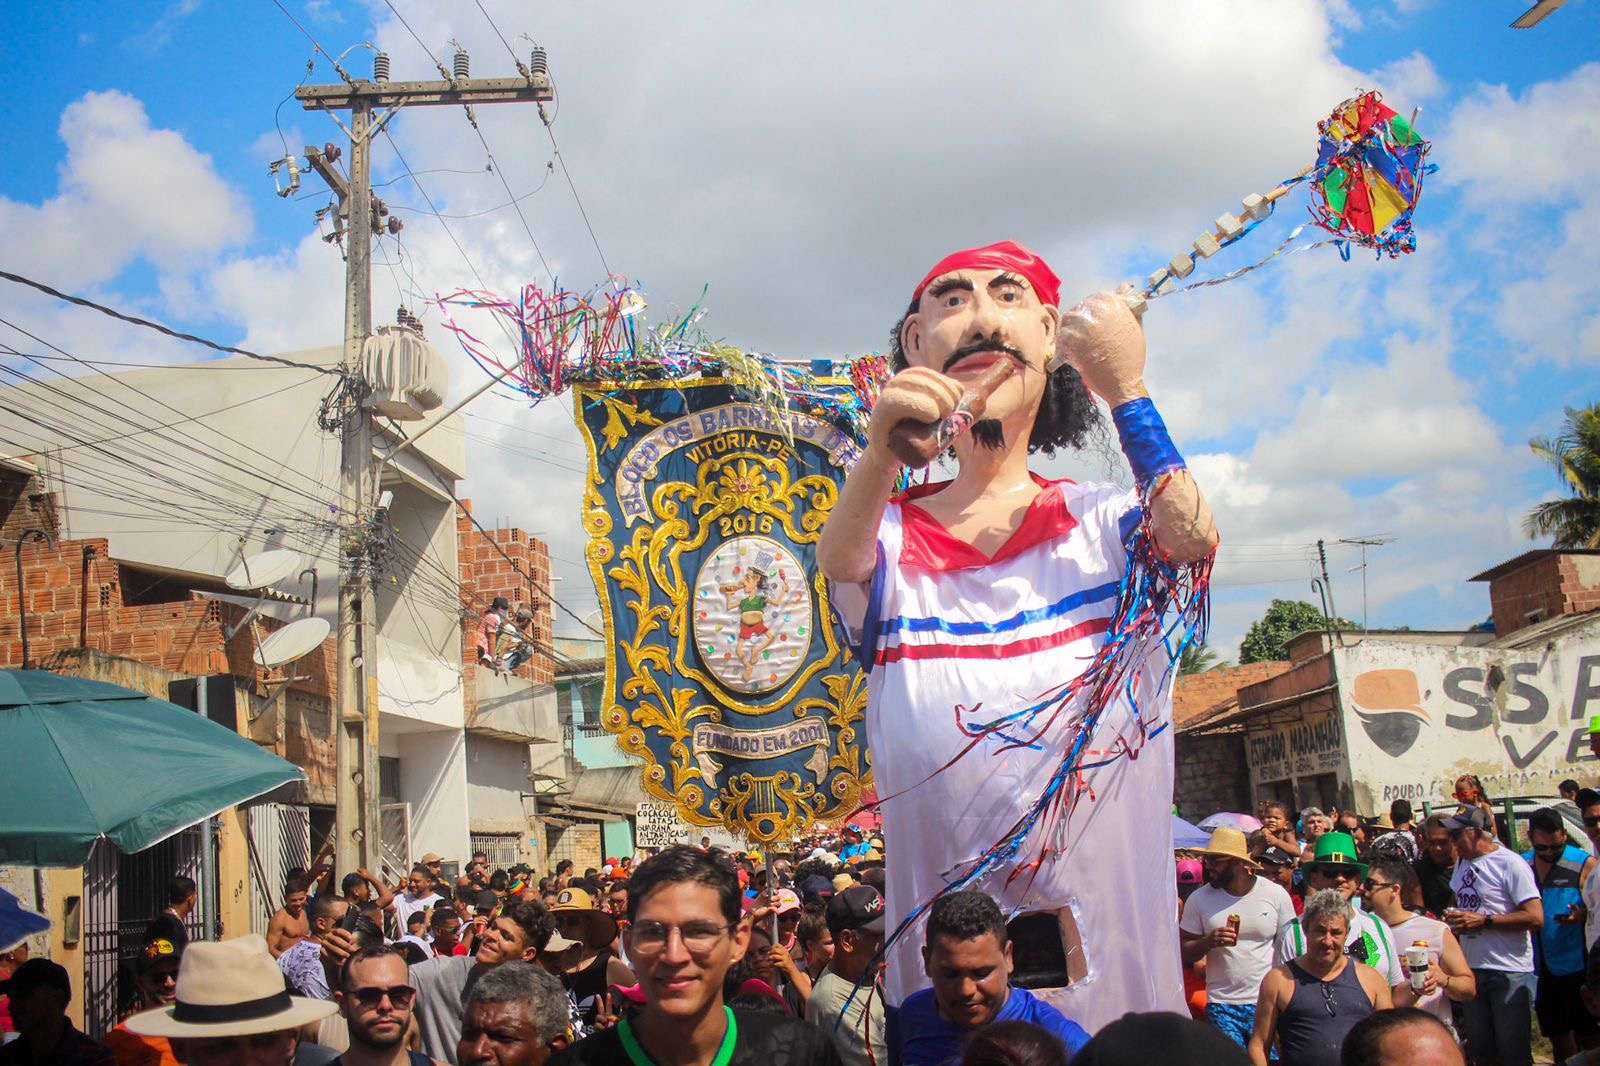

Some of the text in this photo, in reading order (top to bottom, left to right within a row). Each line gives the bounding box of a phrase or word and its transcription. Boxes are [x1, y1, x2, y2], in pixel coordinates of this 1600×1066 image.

[621, 441, 659, 516] BLOCO
[663, 420, 693, 446] OS
[719, 514, 774, 537] 2016
[697, 724, 825, 753] FUNDADO EM 2001
[1384, 783, 1424, 801] ROUBO
